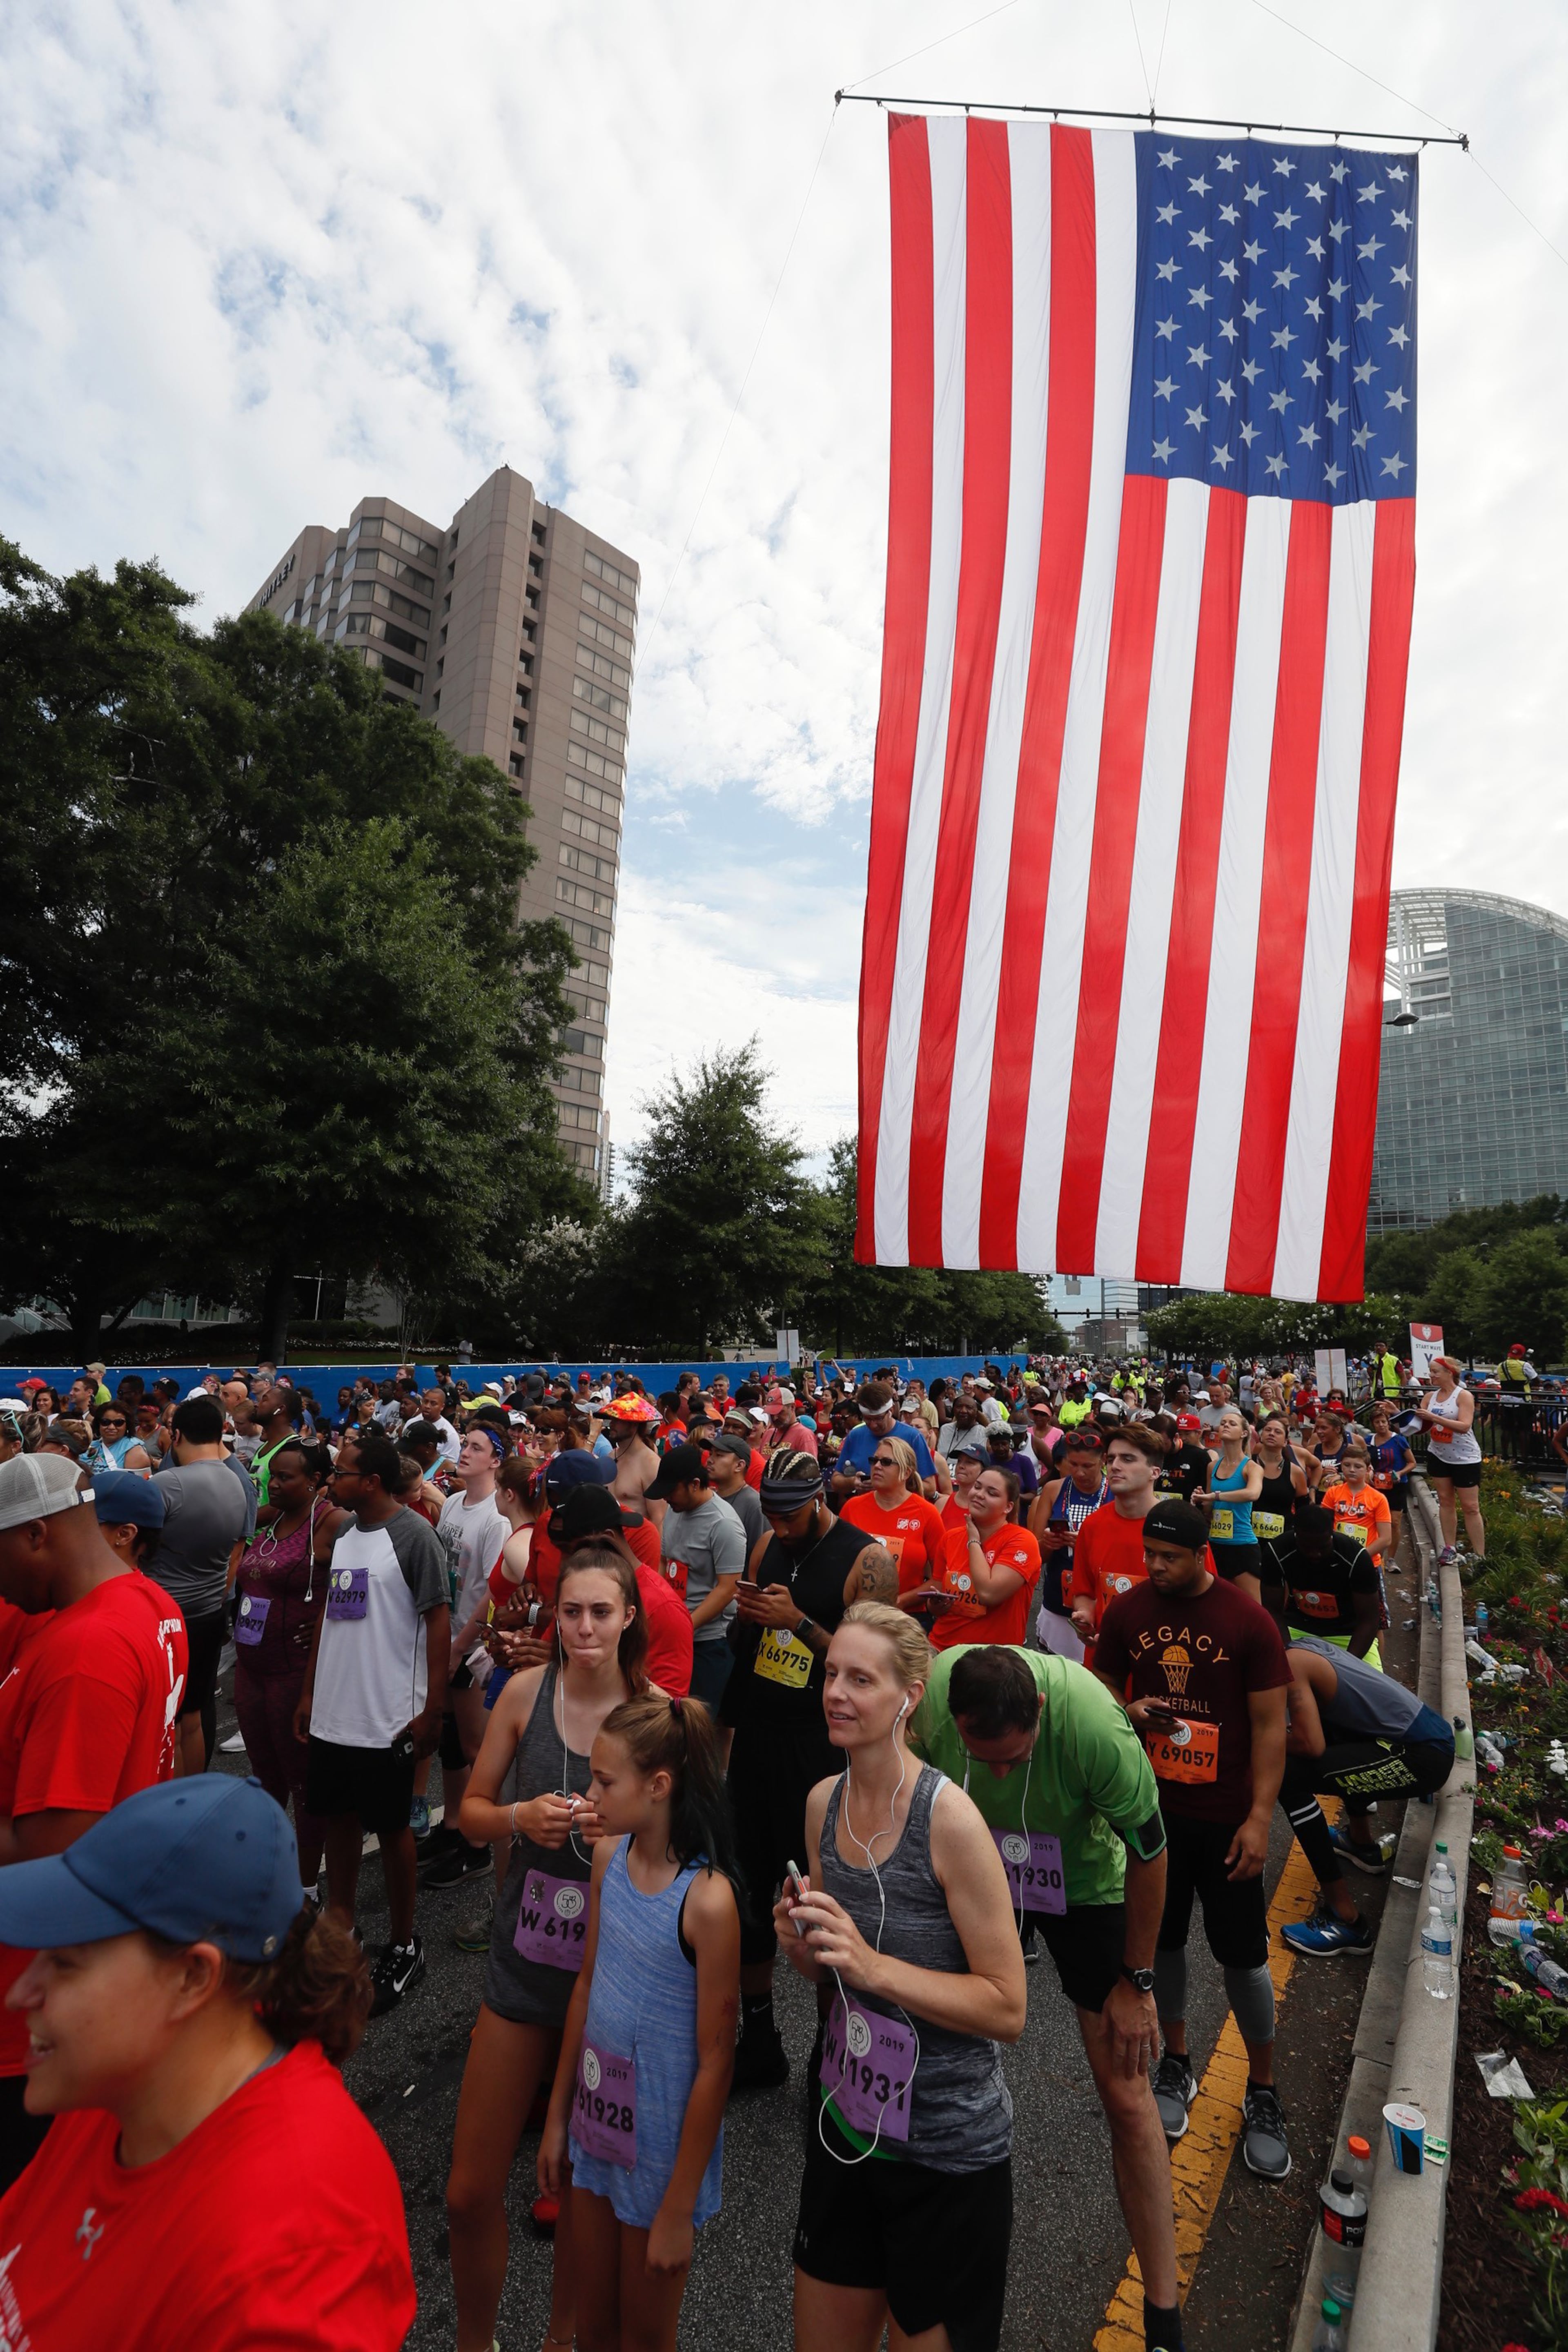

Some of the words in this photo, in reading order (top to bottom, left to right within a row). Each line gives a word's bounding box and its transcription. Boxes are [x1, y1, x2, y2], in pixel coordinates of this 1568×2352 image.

[1321, 1459, 1338, 1467] NIKE
[1260, 1523, 1282, 1533] 66401
[335, 1591, 366, 1604] 62979
[1129, 1626, 1230, 1663] LEGACY
[766, 1646, 809, 1672] 66775
[1145, 1695, 1210, 1713] KETBALL
[1197, 1729, 1214, 1737] 2019
[1148, 1741, 1156, 1757] Y
[1161, 1744, 1215, 1768] 69057
[1335, 1759, 1409, 1788] UNDER
[1034, 1843, 1053, 1851] 2019
[521, 1906, 541, 1931] W
[879, 2035, 904, 2053] 2019
[606, 2067, 627, 2080] 2019
[838, 2049, 906, 2111] 61931
[580, 2085, 634, 2133] 61928
